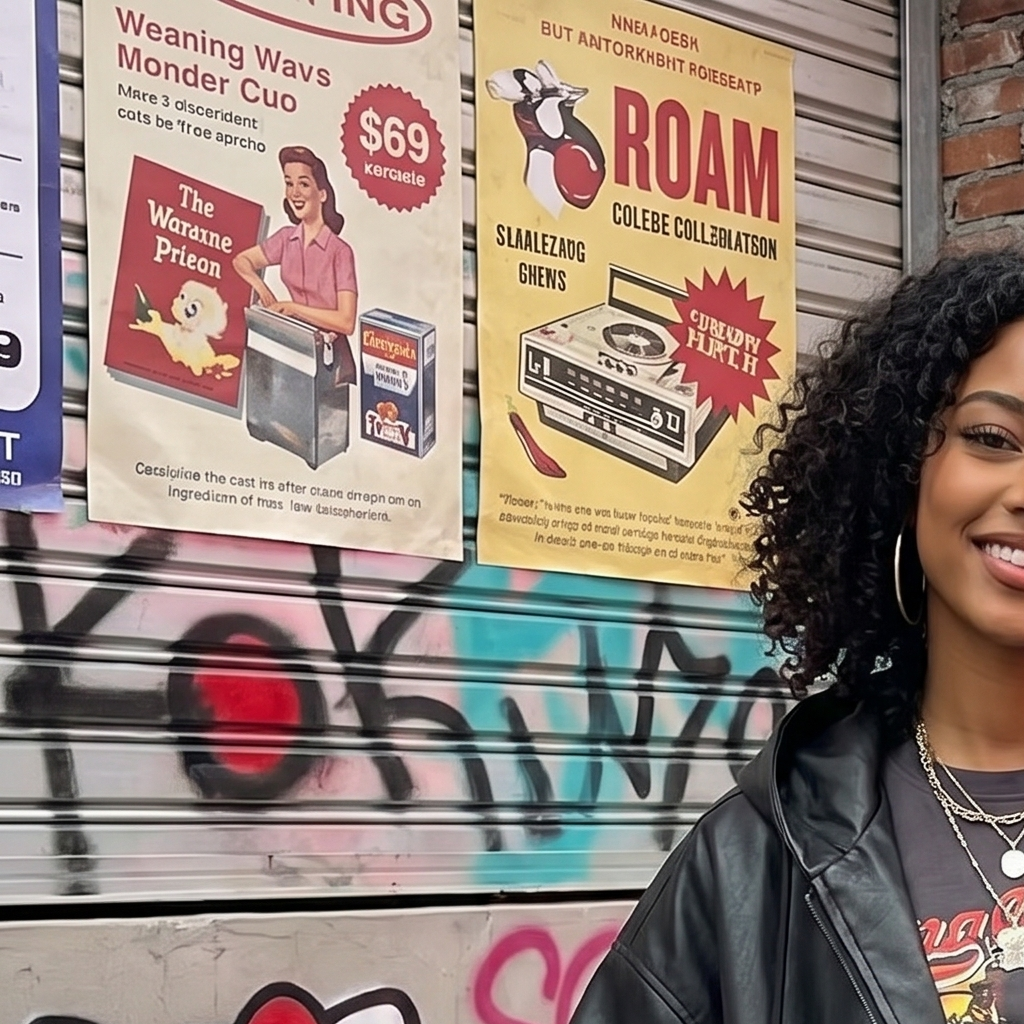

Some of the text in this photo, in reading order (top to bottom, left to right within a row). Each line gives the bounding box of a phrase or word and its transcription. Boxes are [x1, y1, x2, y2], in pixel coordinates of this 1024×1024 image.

[115, 6, 245, 71] Weaning
[541, 20, 574, 42] BUT
[117, 43, 298, 113] Monder Cuo
[161, 94, 170, 108] 3
[155, 114, 174, 131] be
[359, 106, 430, 164] $69
[613, 85, 780, 224] ROAM
[178, 183, 215, 219] The
[612, 201, 670, 236] COLEBE
[204, 471, 226, 485] the
[229, 476, 256, 488] cast
[277, 480, 307, 494] after
[240, 494, 254, 506] of
